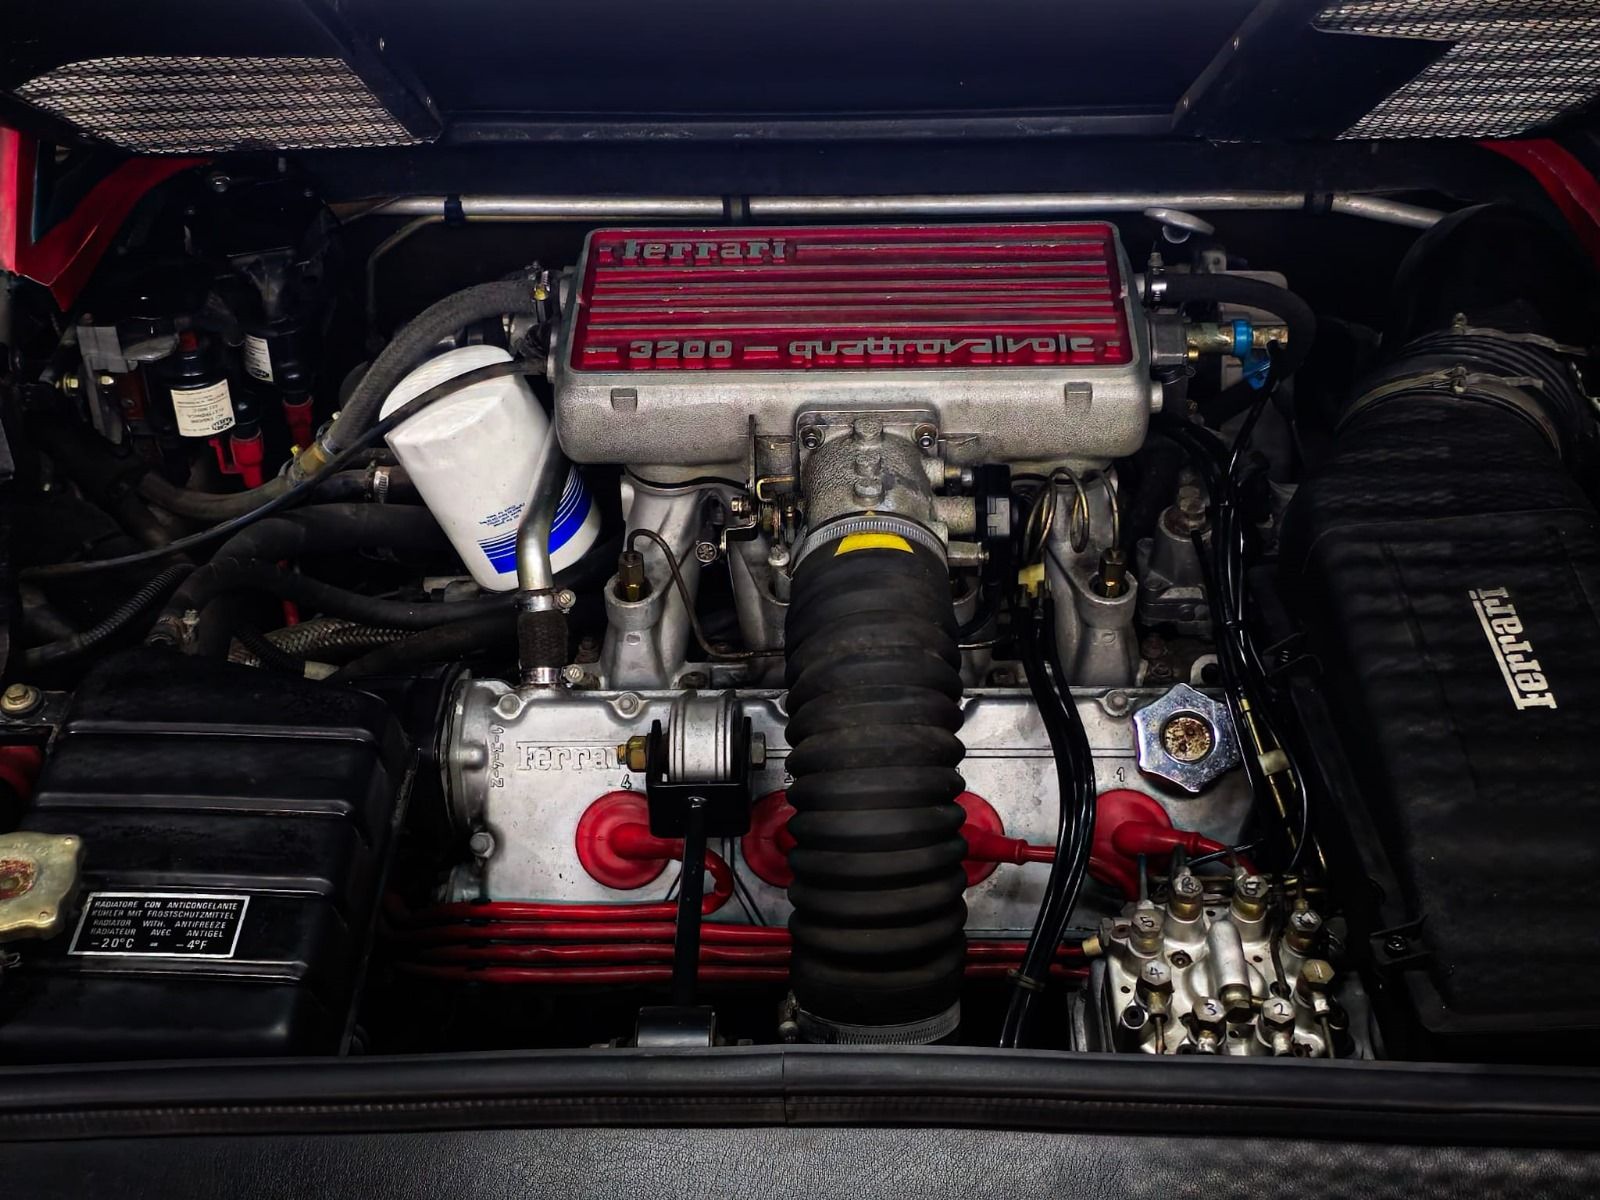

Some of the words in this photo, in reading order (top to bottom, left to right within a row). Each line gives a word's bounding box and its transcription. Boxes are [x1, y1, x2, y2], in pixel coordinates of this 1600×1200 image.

[629, 340, 733, 359] 3200
[788, 334, 1095, 360] quattrovalvole
[621, 773, 632, 789] 4
[94, 901, 139, 909] RADIATORE
[144, 901, 161, 909] CON
[167, 901, 239, 911] ANTICONGELANTE
[127, 909, 143, 918] MIT
[146, 910, 235, 920] FROSTSCHUTZMITTEL
[93, 918, 132, 927] RADIATOR
[174, 920, 227, 929] ANTIFREEZE
[90, 927, 137, 936] RADIATEUR
[150, 928, 172, 937] AVEC
[185, 929, 224, 938] ANTIGEL
[1149, 966, 1164, 978] 4
[1204, 1003, 1218, 1016] 3
[1273, 1002, 1290, 1017] 2
